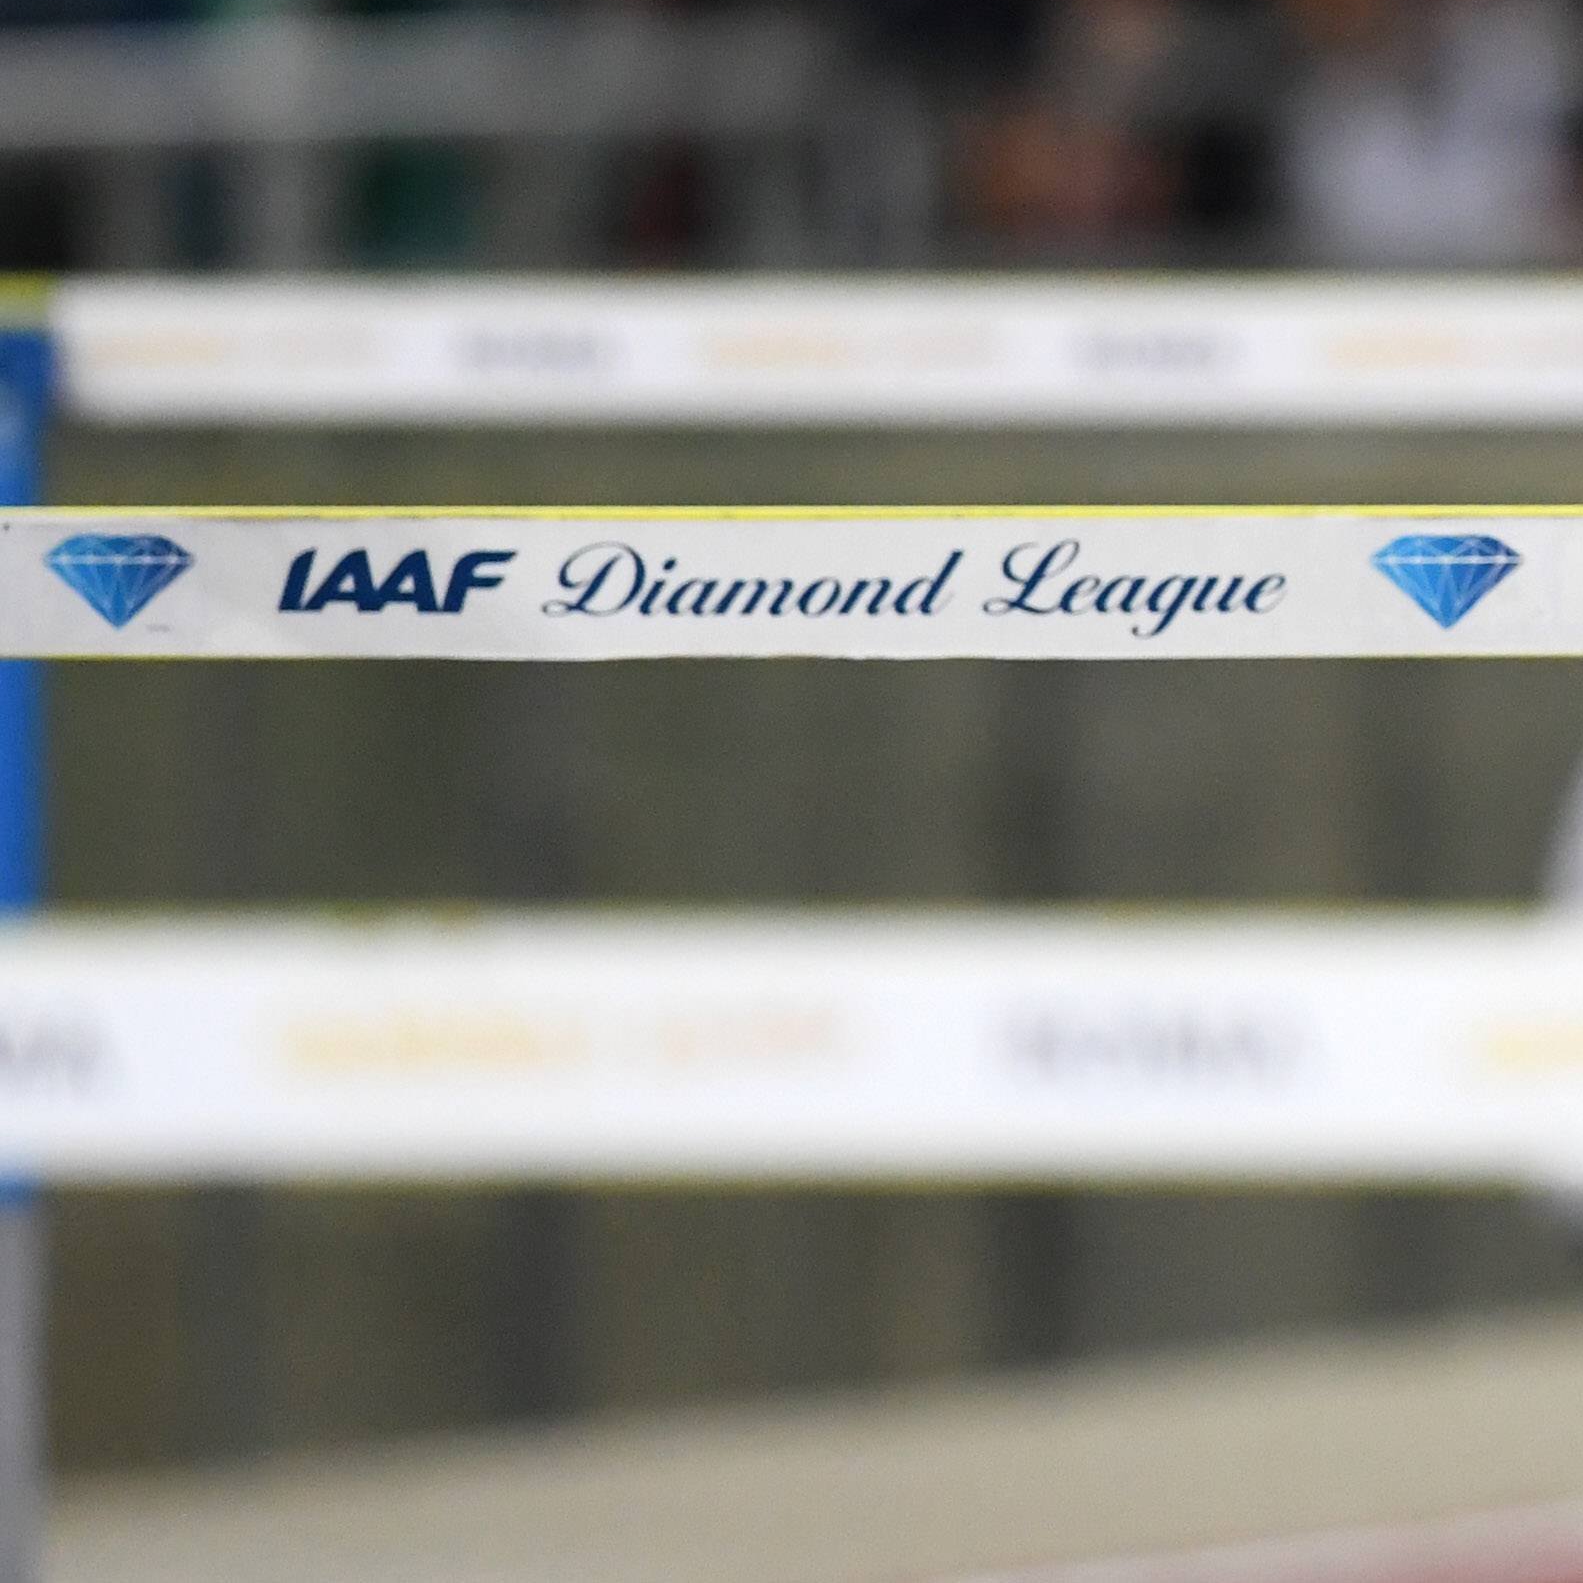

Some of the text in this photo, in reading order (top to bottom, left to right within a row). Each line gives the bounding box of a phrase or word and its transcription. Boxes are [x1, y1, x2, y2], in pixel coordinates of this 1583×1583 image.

[279, 537, 1287, 640] IAAF Diamond League
